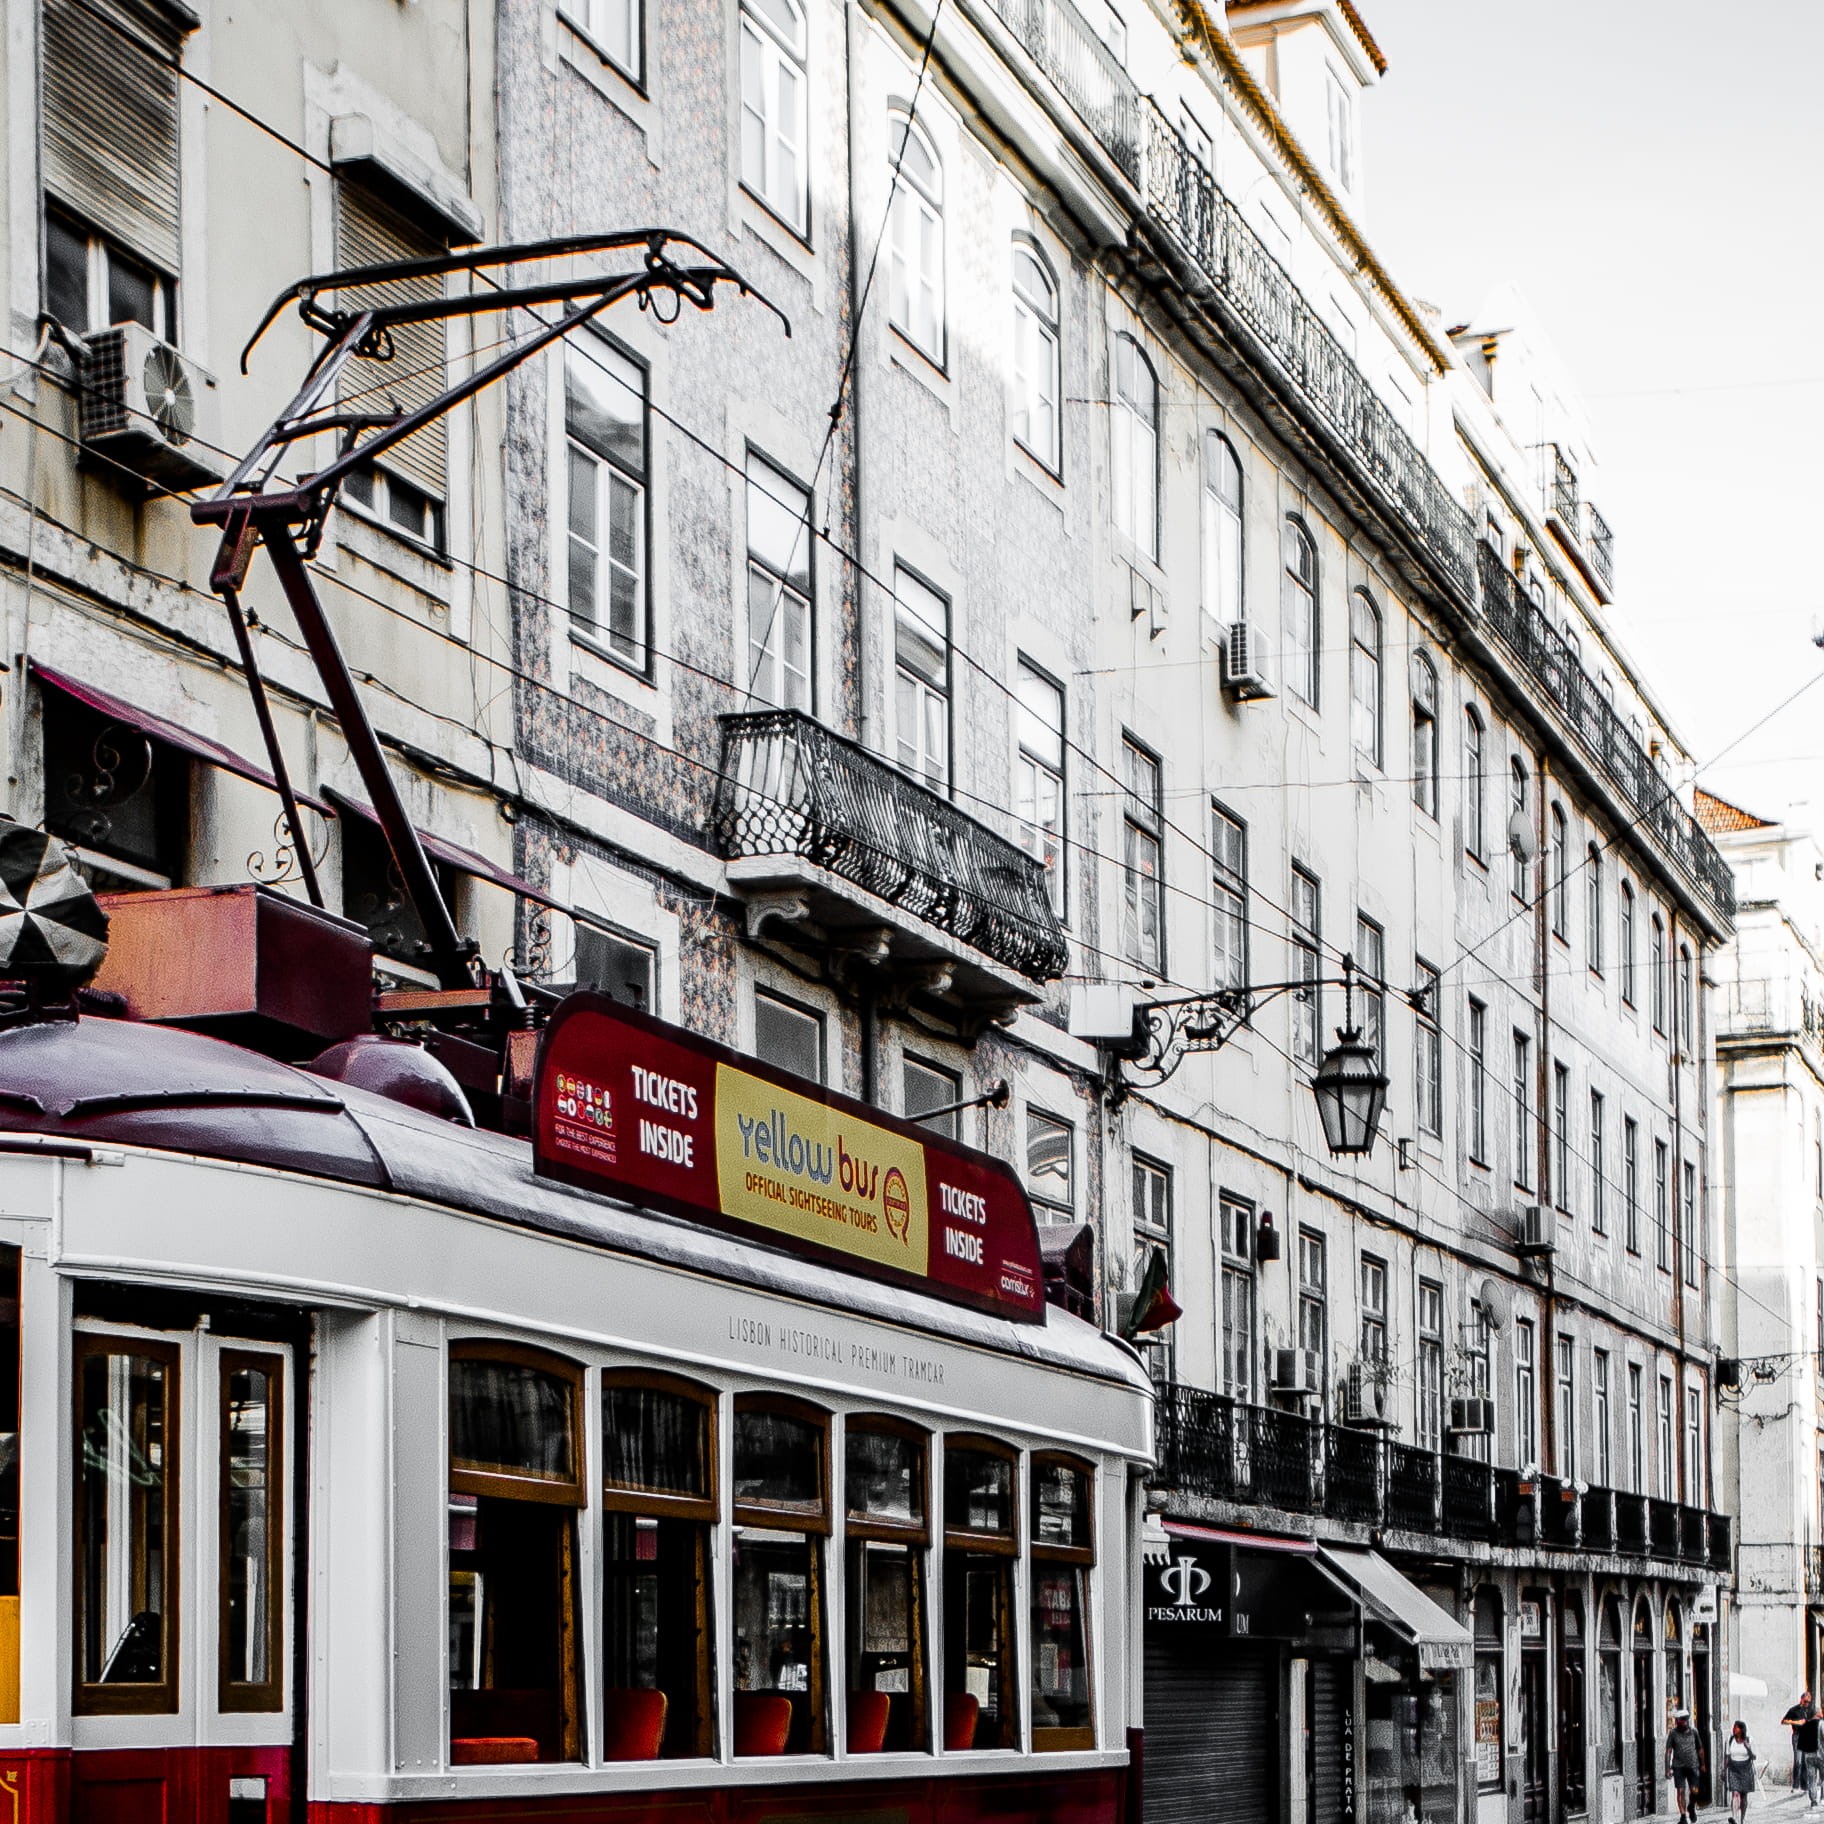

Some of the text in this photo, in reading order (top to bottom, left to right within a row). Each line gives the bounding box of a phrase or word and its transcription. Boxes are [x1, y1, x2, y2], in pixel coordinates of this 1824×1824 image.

[631, 1064, 698, 1120] TICKETS
[640, 1119, 694, 1168] INSIDE
[738, 1109, 878, 1200] yellow bus
[745, 1171, 878, 1234] OFFICIAL SIGHTSEEING TOURS
[940, 1182, 986, 1225] TICKETS
[945, 1226, 984, 1265] INSIDE
[729, 1316, 945, 1385] LISBON HISTORICAL PREMIUM TRAMCAR
[1148, 1607, 1222, 1622] PESARUM
[1345, 1743, 1352, 1761] DE
[1345, 1768, 1353, 1814] PRATA
